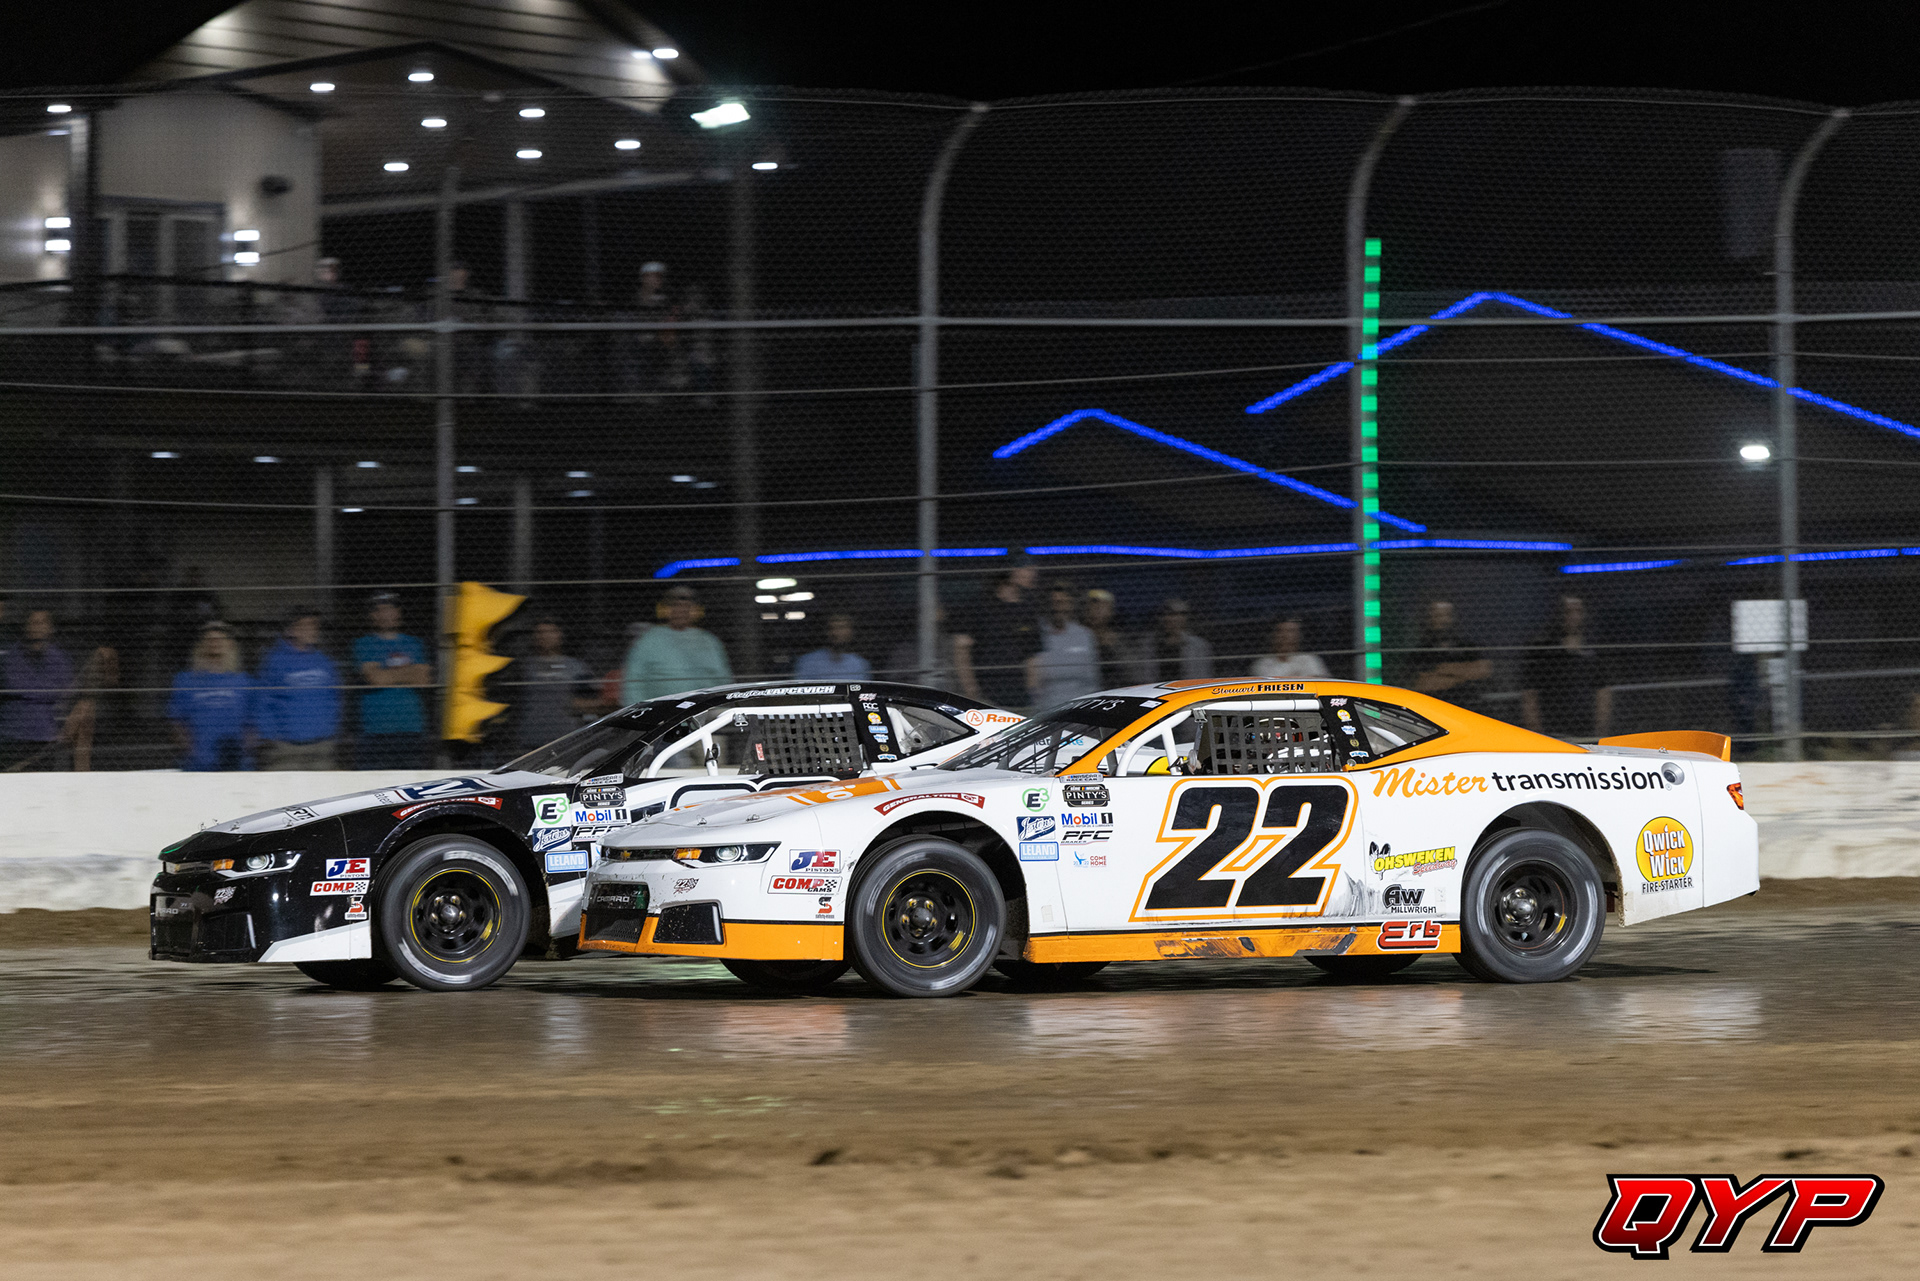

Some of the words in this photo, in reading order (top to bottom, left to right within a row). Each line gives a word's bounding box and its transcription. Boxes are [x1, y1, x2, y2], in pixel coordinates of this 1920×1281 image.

[1211, 686, 1256, 695] Stewart
[1257, 683, 1304, 692] FRIESEN
[1370, 767, 1490, 798] Mister
[1491, 766, 1665, 791] transmission
[582, 791, 624, 801] PINTY'S
[1066, 791, 1107, 799] PINTY'S
[882, 794, 932, 812] GENERAL
[575, 810, 612, 823] Mobil
[1060, 813, 1098, 825] Mobil
[1062, 830, 1114, 841] PFC
[1022, 844, 1056, 856] LELAND
[1144, 785, 1349, 910] 22
[549, 855, 584, 866] LELAND
[791, 851, 837, 871] JE
[1374, 846, 1456, 872] OHSWEKEN
[327, 859, 367, 877] JE
[1412, 859, 1457, 876] Speedway
[313, 882, 355, 892] COMP
[773, 878, 825, 890] COMP
[1642, 877, 1693, 893] FIRE-STARTER
[1378, 920, 1441, 949] Erb
